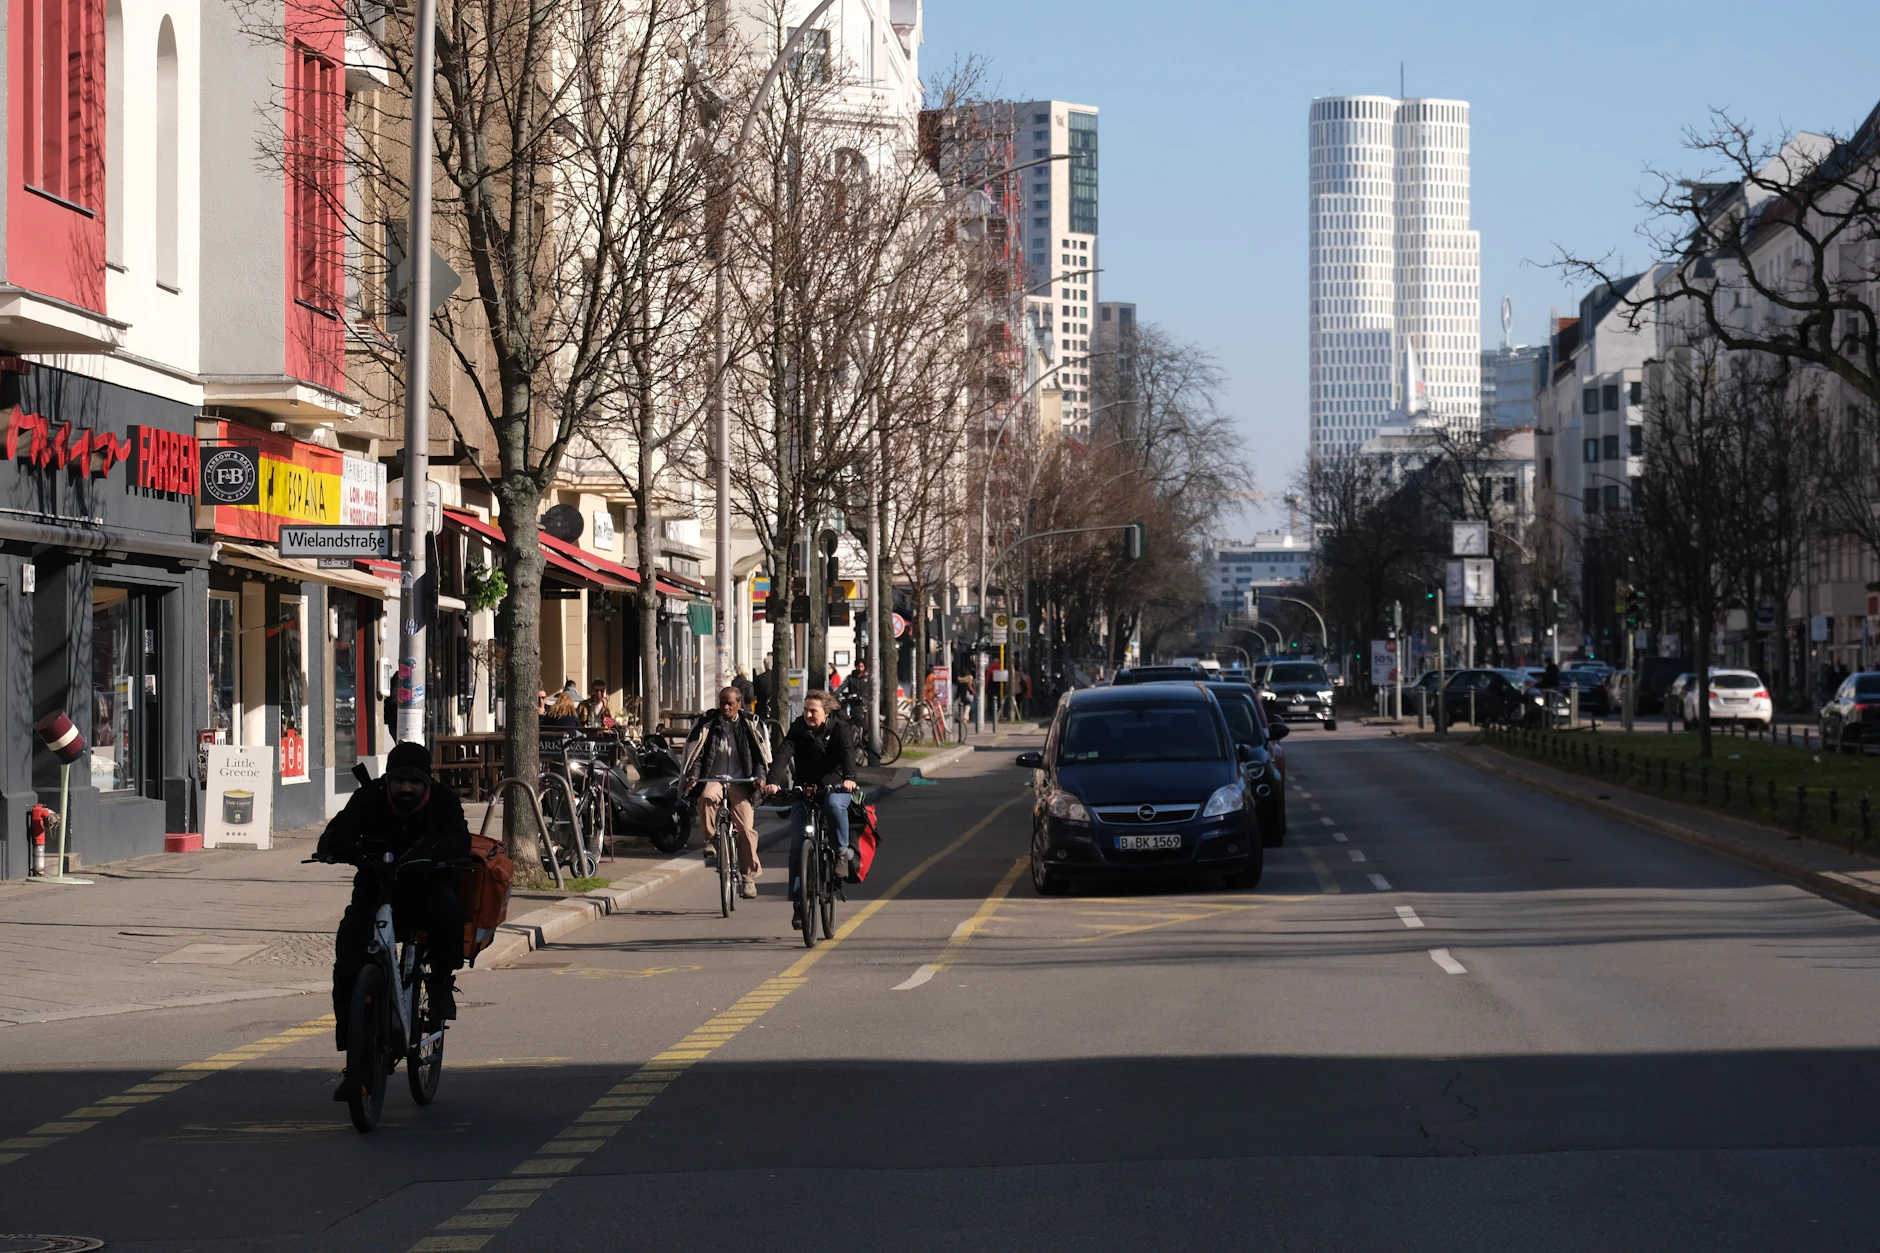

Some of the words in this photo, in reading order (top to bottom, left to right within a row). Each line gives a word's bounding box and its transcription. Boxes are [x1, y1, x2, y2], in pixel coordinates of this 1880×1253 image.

[137, 424, 199, 496] FARBEN
[207, 453, 231, 473] FARROW
[239, 456, 252, 472] BALL
[216, 468, 244, 485] F&B
[207, 481, 225, 498] PAINT
[235, 481, 252, 498] PAPER
[288, 469, 327, 520] ESPAÑA
[350, 486, 360, 504] LON
[287, 531, 385, 552] Wielandstraße
[226, 758, 255, 768] Little
[219, 768, 260, 777] Greene
[1121, 838, 1128, 849] B
[1135, 837, 1150, 848] BK
[1152, 836, 1180, 848] 1569
